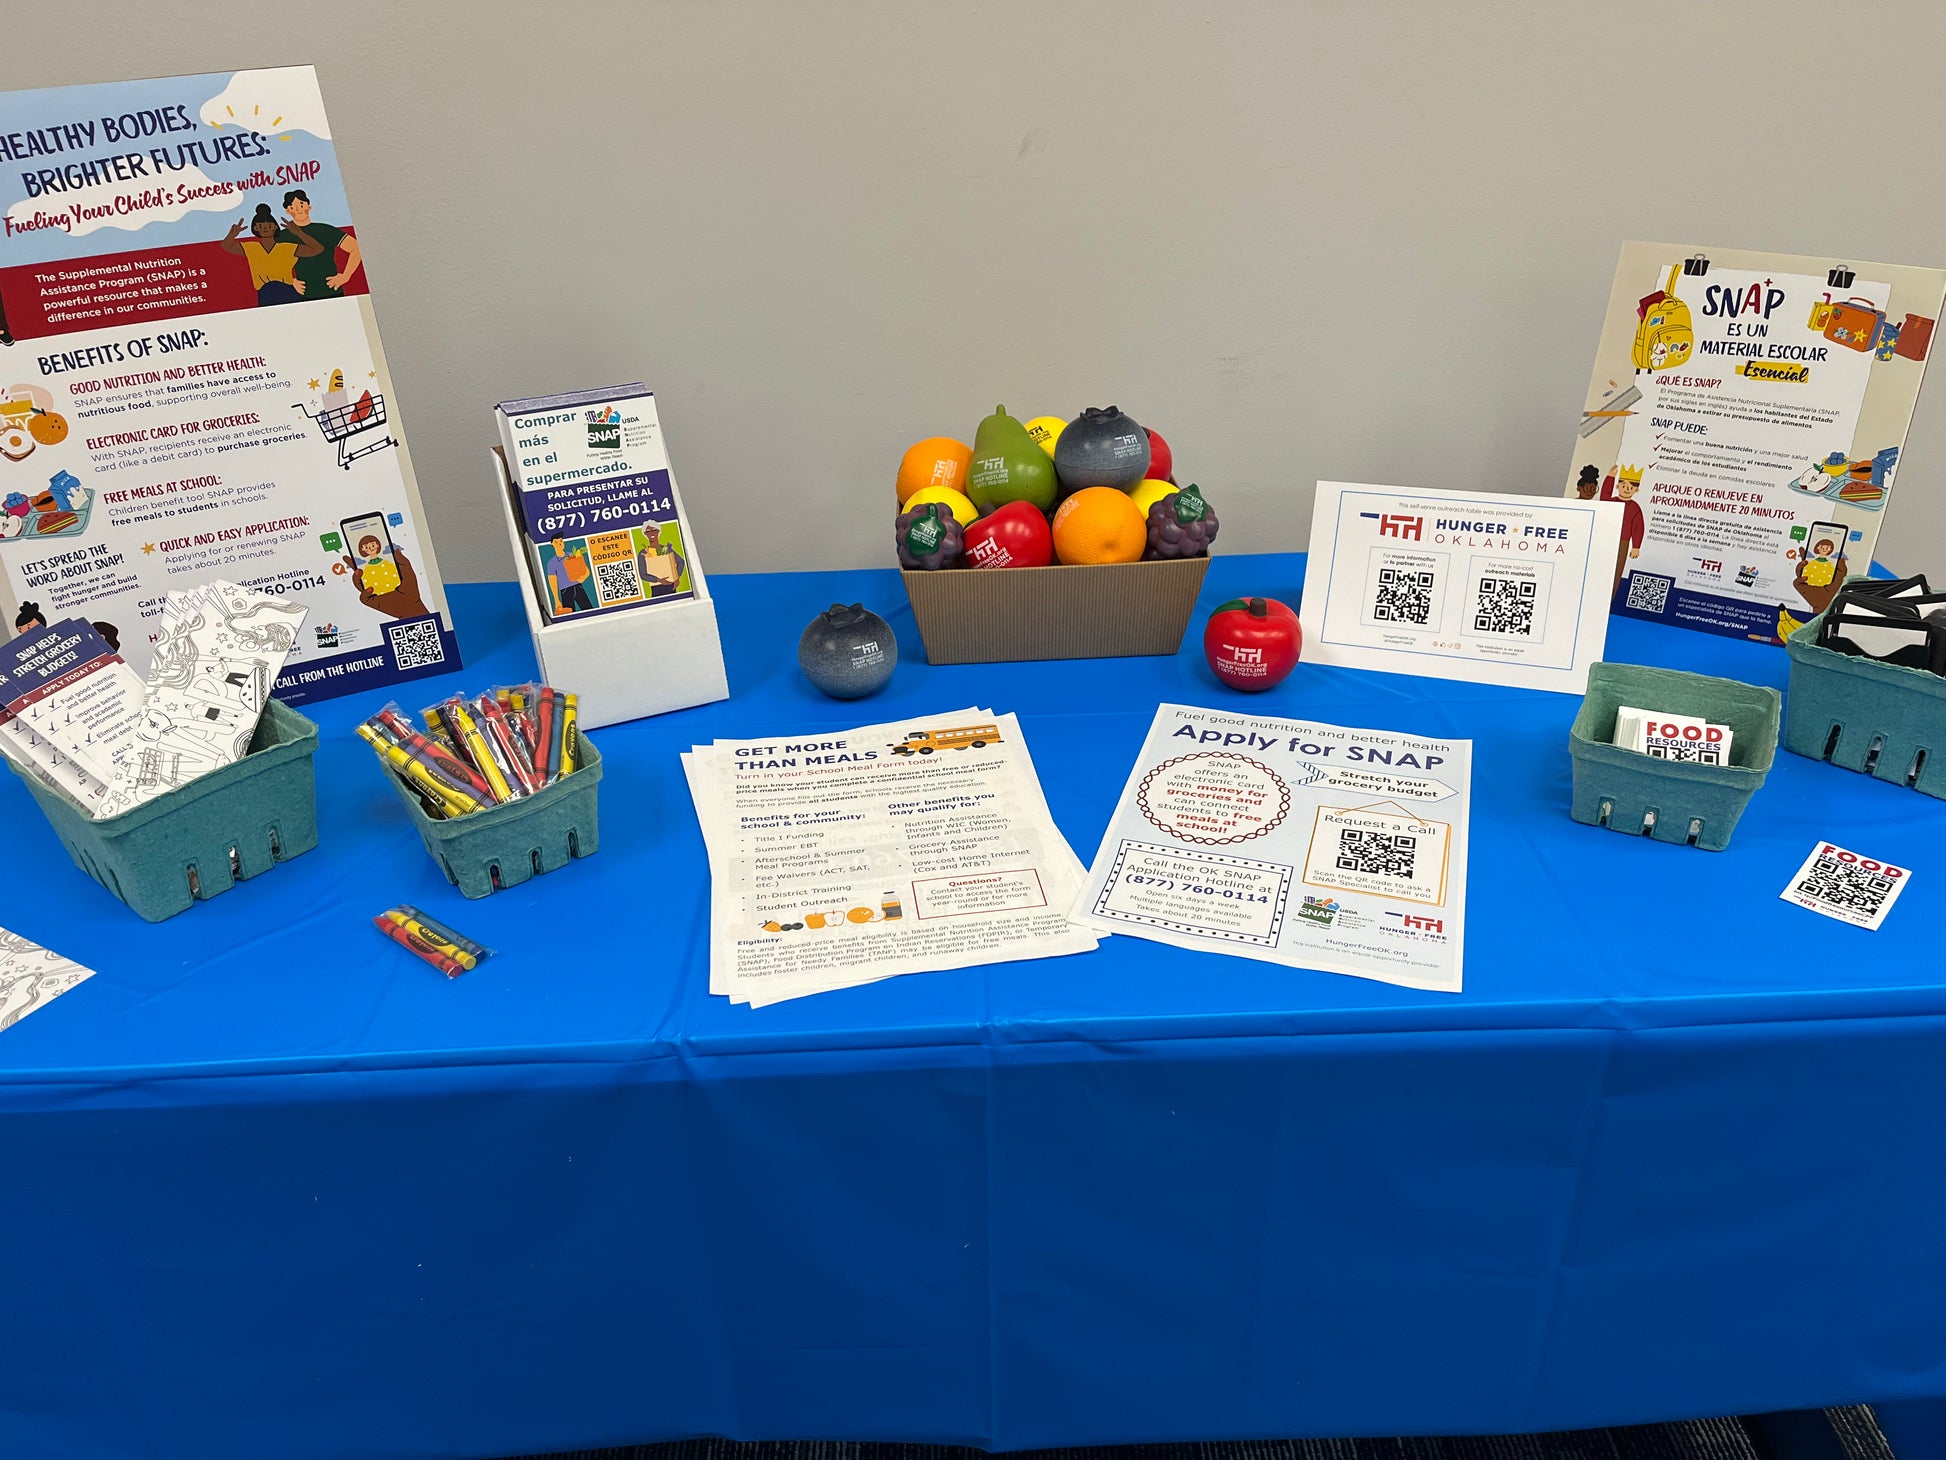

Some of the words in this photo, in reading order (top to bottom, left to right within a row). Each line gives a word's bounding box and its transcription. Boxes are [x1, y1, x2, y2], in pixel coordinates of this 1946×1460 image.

[0, 120, 94, 162] HEALTHY
[100, 104, 197, 142] BODIES,
[21, 152, 149, 197] BRIGHTER
[149, 131, 270, 174] FUTURES:
[1, 211, 71, 238] Fueling
[68, 203, 114, 224] Your
[114, 187, 174, 215] Child's
[176, 181, 233, 204] Success
[236, 170, 274, 191] with
[275, 159, 320, 186] SNAP
[34, 273, 56, 283] The
[58, 262, 132, 280] Supplemental
[133, 257, 181, 270] Nutrition
[40, 282, 96, 296] Assistance
[98, 276, 144, 288] Program
[146, 269, 185, 282] (SNAP)
[187, 268, 197, 276] is
[1702, 283, 1785, 320] SNAP
[1726, 322, 1742, 336] ES
[1746, 323, 1768, 337] UN
[37, 342, 124, 375] BENEFITS
[126, 337, 152, 358] OF
[156, 328, 208, 353] SNAP:
[1699, 340, 1764, 357] MATERIAL
[1767, 344, 1828, 361] ESCOLAR
[69, 380, 101, 395] GOOD
[103, 370, 161, 390] NUTRITION
[163, 367, 185, 381] AND
[187, 361, 225, 377] BETTER
[225, 356, 266, 371] HEALTH:
[1655, 375, 1681, 386] ¿QUÉ
[1682, 376, 1692, 386] ES
[1693, 377, 1722, 389] SNAP?
[1743, 360, 1809, 383] Esencial
[85, 429, 149, 450] ELECTRONIC
[150, 425, 178, 439] CARD
[180, 421, 201, 434] FOR
[202, 412, 260, 431] GROCERIES:
[514, 412, 576, 429] Comprar
[621, 416, 639, 424] USDA
[1650, 417, 1673, 428] SNAP
[1673, 420, 1708, 435] PUEDE:
[518, 433, 548, 448] más
[587, 429, 620, 445] SNAP
[522, 456, 540, 467] en
[544, 451, 557, 463] el
[526, 460, 632, 485] supermercado.
[103, 489, 129, 504] FREE
[130, 484, 164, 499] MEALS
[166, 481, 177, 493] AT
[179, 474, 222, 491] SCHOOL:
[547, 488, 574, 499] PARA
[576, 478, 633, 495] PRESENTAR
[634, 476, 648, 485] SU
[1652, 482, 1693, 495] APLIQUE
[1693, 487, 1702, 496] O
[1703, 488, 1748, 502] RENUEVE
[1750, 493, 1763, 503] EN
[547, 496, 605, 512] SOLICITUD,
[607, 489, 638, 501] LLAME
[641, 487, 653, 496] AL
[1649, 495, 1737, 513] APROXIMADAMENTE
[1738, 505, 1750, 515] 20
[1750, 506, 1795, 520] MINUTOS
[537, 511, 585, 534] (877)
[590, 497, 671, 522] 760-0114
[159, 536, 192, 552] QUICK
[193, 532, 215, 546] AND
[217, 527, 241, 541] EASY
[245, 515, 310, 536] APPLICATION:
[597, 533, 627, 543] ESCANEE
[1436, 518, 1507, 536] HUNGER
[1524, 526, 1569, 540] FREE
[603, 543, 619, 551] ESTE
[1434, 533, 1564, 554] OKLAHOMA
[20, 559, 48, 575] LET'S
[47, 549, 87, 568] SPREAD
[87, 543, 108, 557] THE
[592, 551, 621, 561] CÓDIGO
[622, 549, 633, 557] QR
[25, 571, 58, 588] WORD
[60, 561, 92, 579] ABOUT
[94, 554, 124, 570] SNAP!
[278, 568, 310, 580] Hotline
[12, 653, 48, 677] STRETCH
[44, 634, 82, 658] GROCERY
[15, 645, 37, 661] SNAP
[34, 632, 61, 650] HELPS
[37, 650, 78, 677] BUDGETS!
[276, 676, 298, 689] CALL
[298, 668, 326, 683] FROM
[325, 664, 344, 677] THE
[345, 656, 384, 673] HOTLINE
[1175, 710, 1205, 720] Fuel
[1209, 716, 1245, 725] good
[1250, 722, 1312, 734] nutrition
[1317, 730, 1345, 739] and
[1351, 734, 1397, 745] better
[1402, 739, 1449, 752] health
[1646, 721, 1723, 743] FOOD
[734, 746, 777, 756] GET
[785, 740, 847, 753] MORE
[1172, 724, 1279, 752] Apply
[1288, 738, 1335, 757] for
[1346, 746, 1444, 770] SNAP
[1646, 736, 1720, 750] RESOURCES
[734, 758, 796, 770] THAN
[805, 750, 877, 765] MEALS
[806, 766, 843, 775] School
[847, 763, 872, 771] Meal
[907, 756, 942, 765] today!
[1327, 775, 1382, 791] grocery
[1387, 785, 1437, 797] budget
[1340, 771, 1391, 783] Stretch
[1396, 779, 1428, 787] your
[887, 801, 920, 809] Other
[924, 796, 971, 805] benefits
[917, 803, 956, 813] qualify
[740, 821, 779, 829] school
[795, 813, 865, 825] community:
[741, 814, 790, 822] Benefits
[814, 810, 840, 818] your
[1324, 814, 1386, 828] Request
[1407, 823, 1435, 835] Call
[1143, 857, 1168, 868] Call
[1172, 862, 1194, 872] the
[1199, 866, 1219, 875] OK
[1223, 870, 1261, 881] SNAP
[1819, 853, 1898, 884] RESOURCES
[1821, 845, 1903, 878] FOOD
[948, 876, 1002, 887] Questions?
[1125, 873, 1174, 890] (877)
[1181, 883, 1268, 903] 760-0114
[1126, 864, 1200, 882] Application
[1205, 876, 1253, 890] Hotline
[1325, 938, 1408, 957] HungerFreeOK.org
